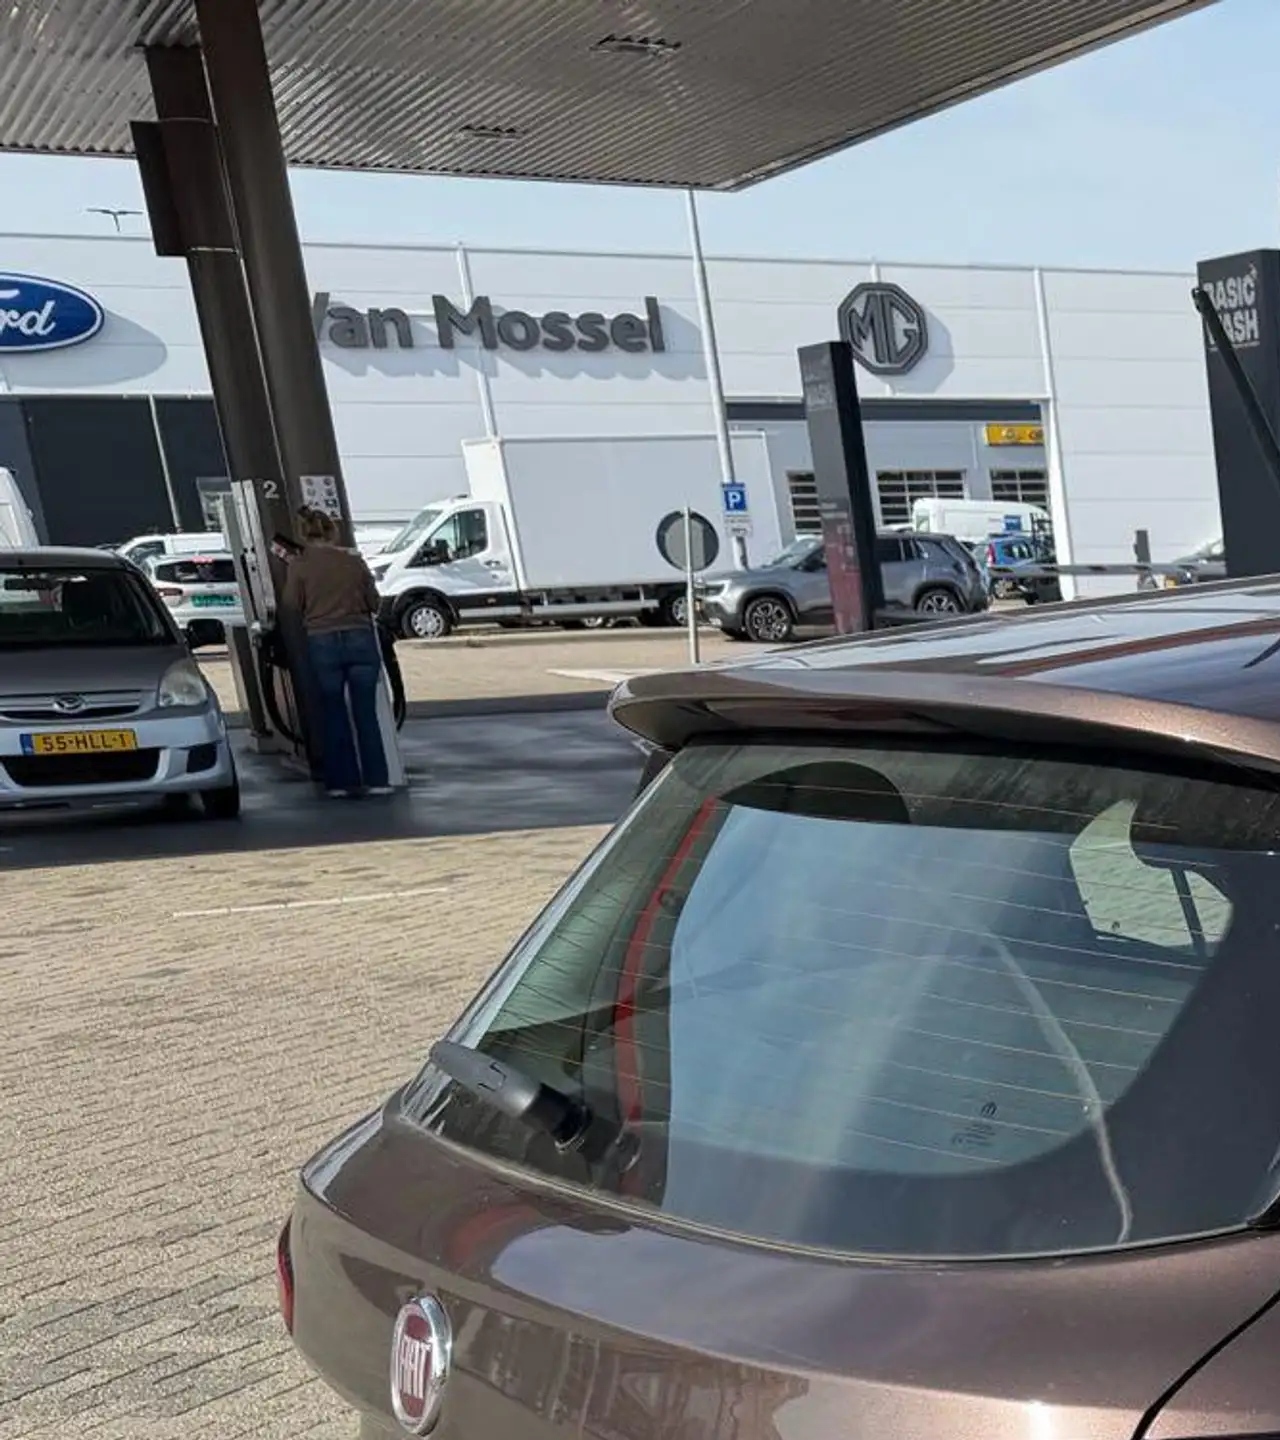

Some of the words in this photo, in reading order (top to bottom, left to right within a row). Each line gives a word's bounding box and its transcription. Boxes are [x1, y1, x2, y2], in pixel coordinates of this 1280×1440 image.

[0, 291, 56, 336] rd
[432, 294, 666, 352] Mossel
[849, 293, 918, 364] MG
[1207, 308, 1260, 345] ASH
[263, 480, 280, 499] 2
[729, 492, 741, 509] P
[399, 1333, 434, 1400] FIAT
